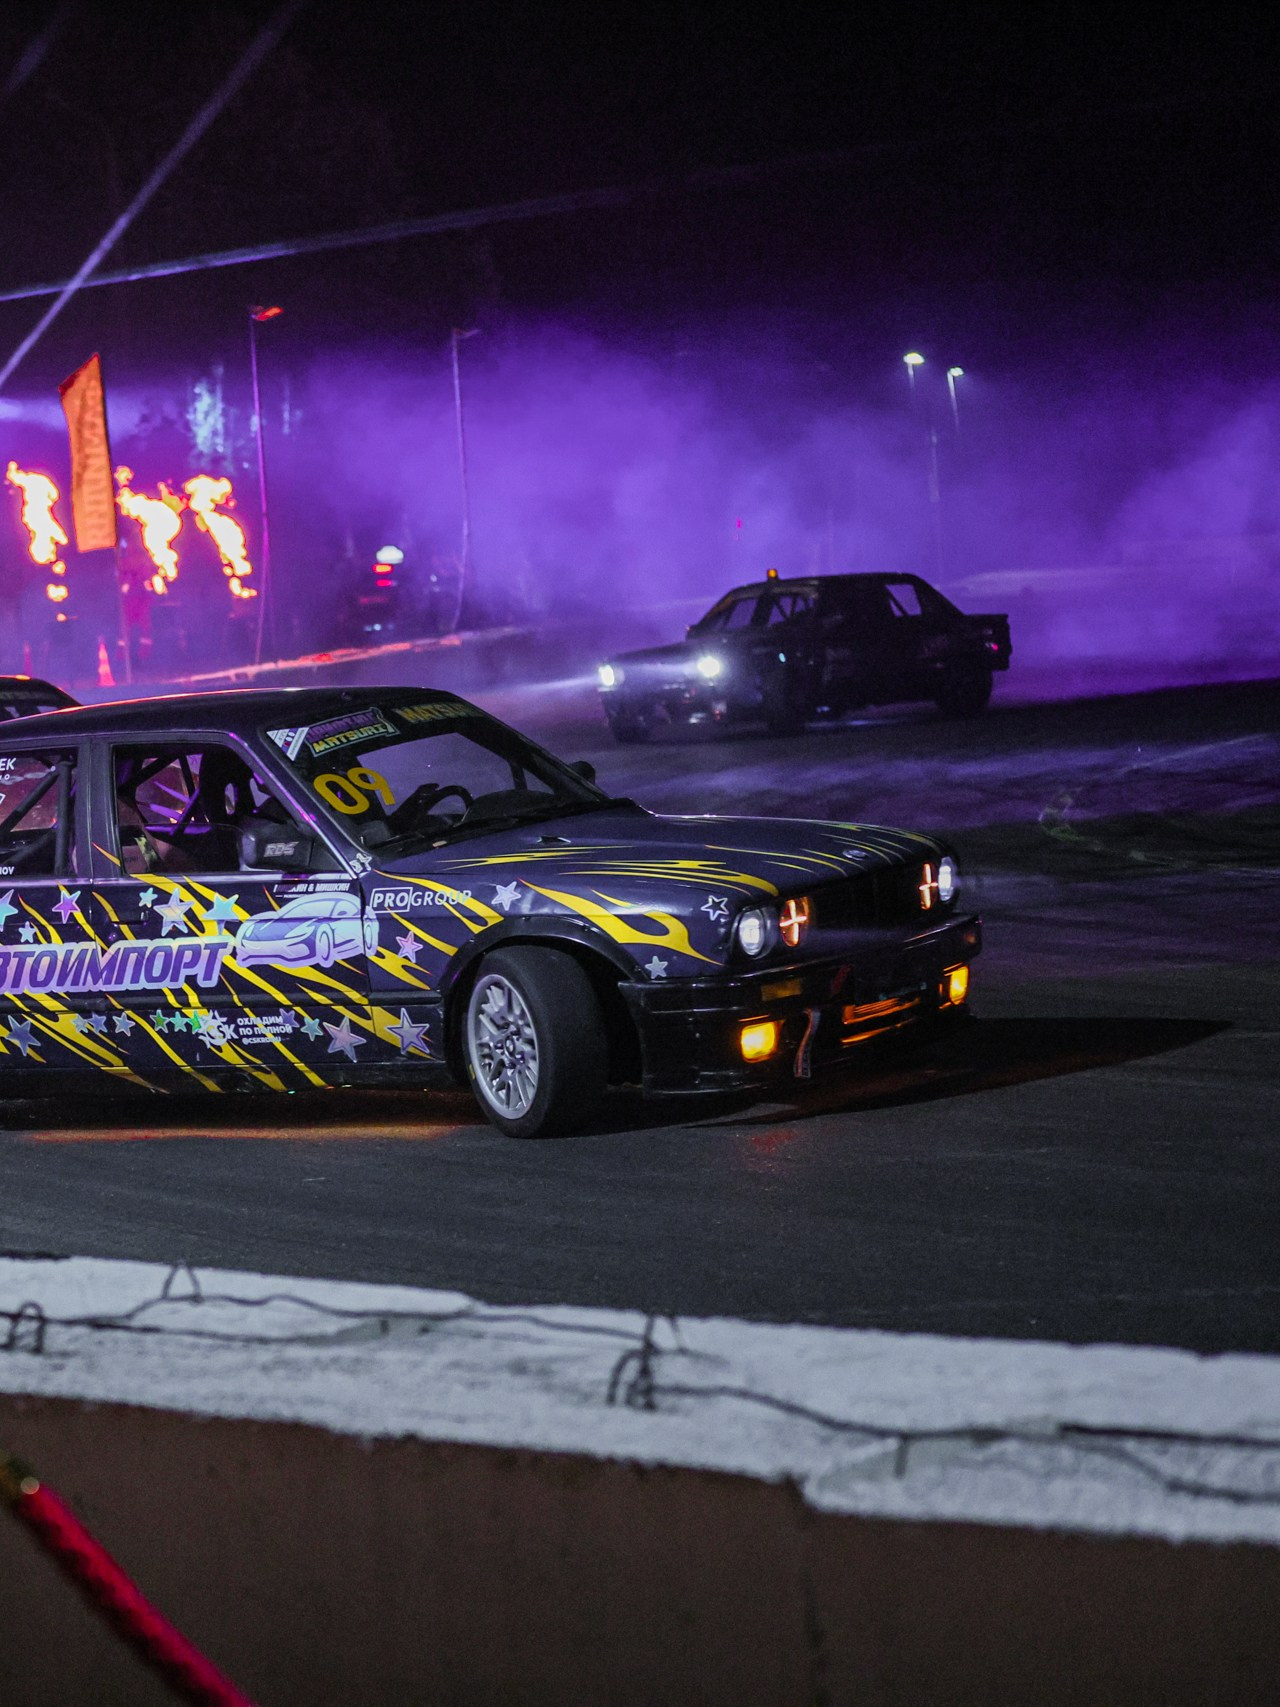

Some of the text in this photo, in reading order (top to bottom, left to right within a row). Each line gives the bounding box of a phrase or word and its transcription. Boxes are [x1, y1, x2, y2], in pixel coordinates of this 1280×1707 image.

[312, 722, 389, 752] MATSURI
[313, 767, 396, 815] 09
[263, 841, 300, 858] RDS
[236, 1015, 284, 1026] ОХЛАДИМ
[239, 1024, 293, 1036] ПО ПОЛНОЙ
